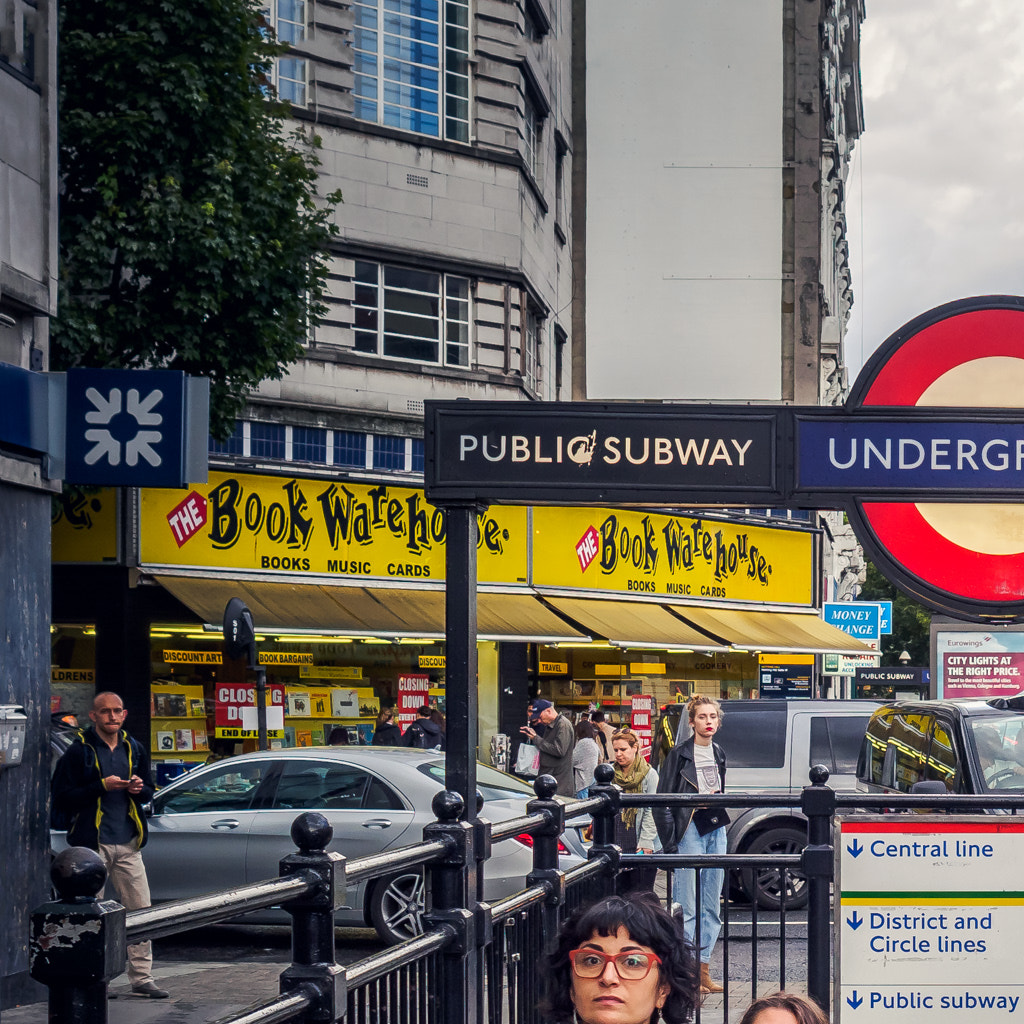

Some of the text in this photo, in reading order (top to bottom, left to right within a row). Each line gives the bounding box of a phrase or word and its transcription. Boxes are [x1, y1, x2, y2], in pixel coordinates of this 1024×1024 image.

[459, 435, 753, 466] PUBLIC SUBWAY
[169, 498, 204, 542] THE
[207, 478, 315, 551] Book
[577, 530, 597, 568] THE
[599, 514, 660, 576] Book
[261, 555, 431, 577] BOOKS MUSIC CARDS
[627, 579, 727, 598] BOOKS MUSIC CARDS
[831, 610, 872, 621] MONEY
[833, 623, 874, 635] HANGE
[947, 639, 984, 648] Eurowings
[163, 651, 223, 663] DISCOUNT ART
[259, 653, 313, 664] BOOK BARGAINS
[947, 656, 1012, 665] CITY LIGHTS AT
[541, 663, 562, 673] TRAVEL
[947, 666, 1021, 676] THE RIGHT PRICE.
[860, 672, 886, 680] PUBLIC
[398, 677, 429, 691] CLOSING
[219, 687, 283, 704] CLOSG
[402, 695, 425, 709] DOWN
[221, 729, 240, 738] END
[253, 729, 278, 738] LSE
[870, 840, 994, 858] Central line
[870, 912, 992, 930] District and
[869, 935, 987, 953] Circle lines
[870, 992, 1020, 1013] Public subway
